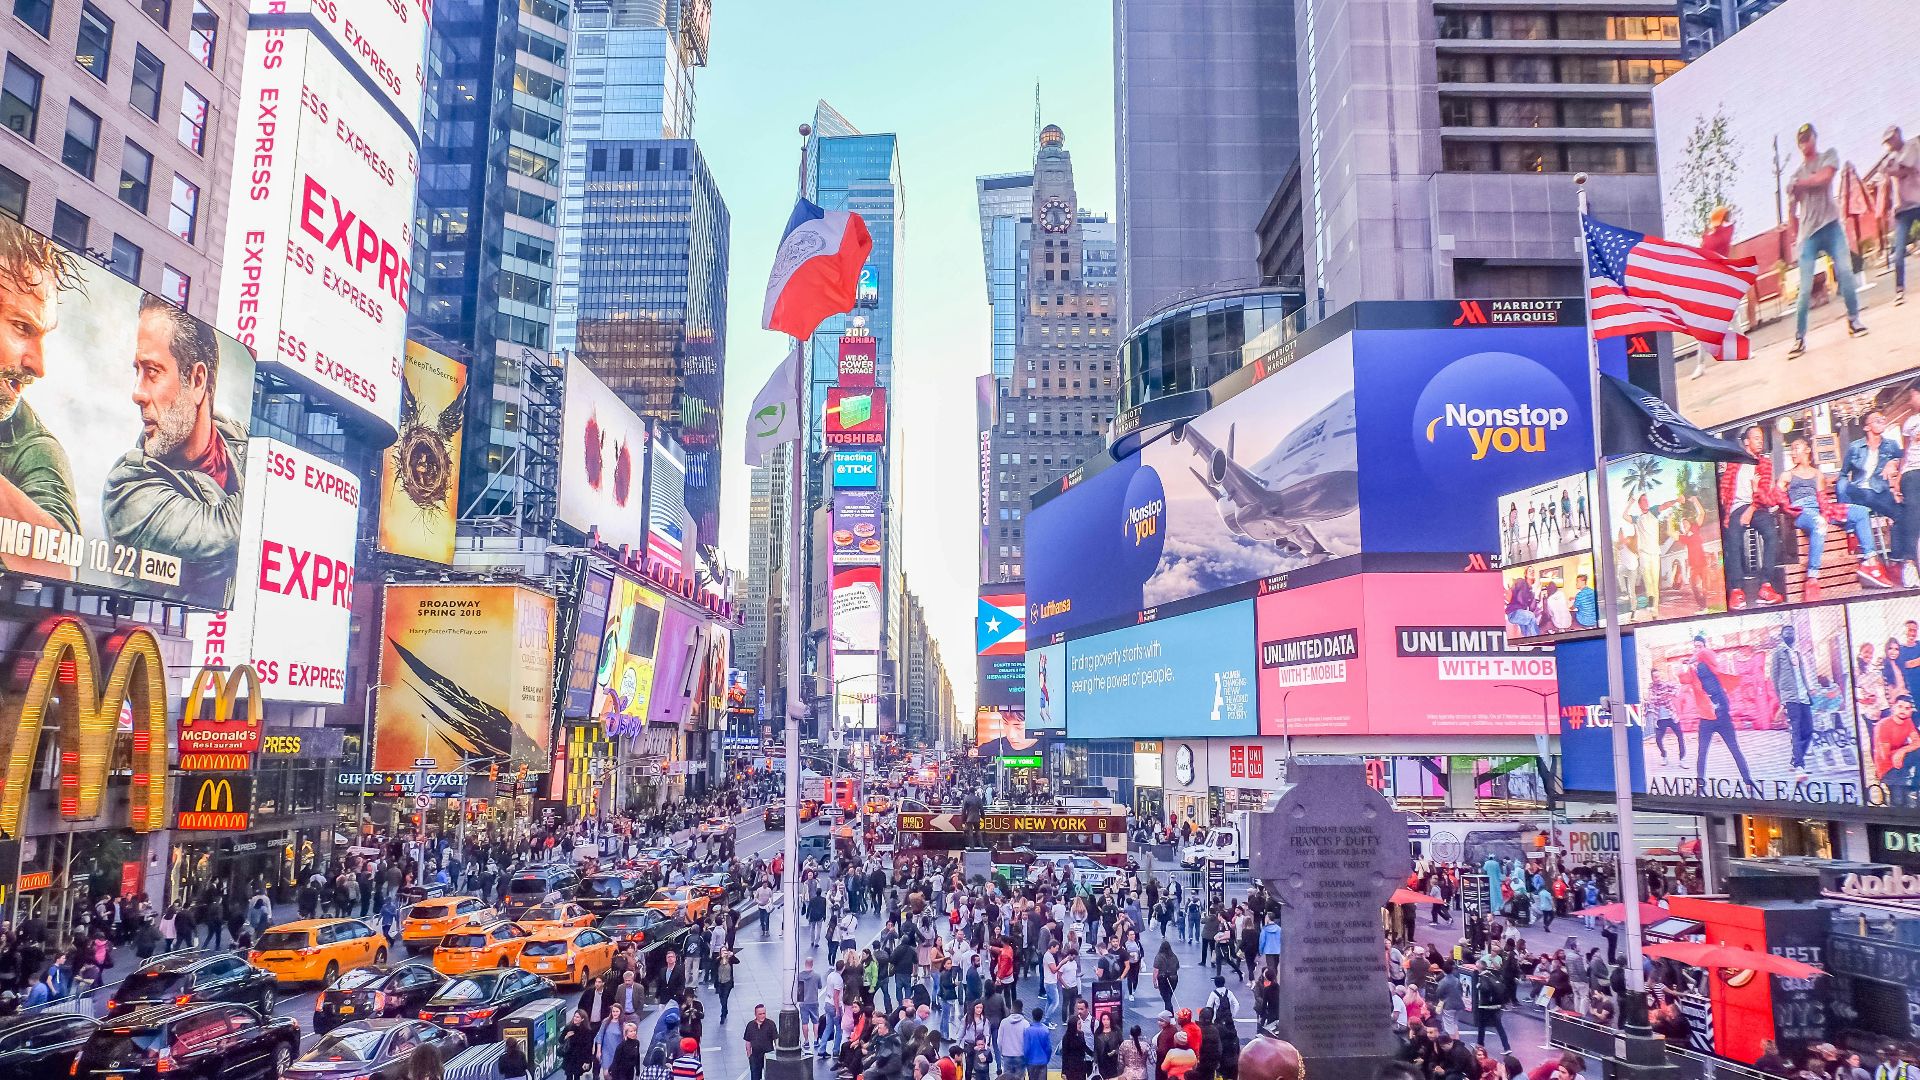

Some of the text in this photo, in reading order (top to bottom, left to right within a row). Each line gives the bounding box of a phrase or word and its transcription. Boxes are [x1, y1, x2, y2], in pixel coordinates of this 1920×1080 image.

[344, 19, 401, 96] EXPRESS
[249, 88, 279, 201] EXPRESS
[337, 119, 395, 187] EXPRESS
[323, 266, 384, 324] EXPRESS
[1492, 301, 1564, 311] MARRIOTT
[1492, 312, 1556, 322] MARQUIS
[1267, 340, 1297, 362] MARRIOTT
[839, 361, 874, 369] POWER
[1267, 353, 1294, 373] MARQUIS
[315, 351, 378, 403] EXPRESS
[1445, 403, 1568, 431] Nonstop
[826, 433, 884, 444] TOSHIBA
[1467, 426, 1547, 461] you
[844, 465, 874, 474] TDK
[304, 465, 360, 509] EXPRESS
[1129, 499, 1162, 525] Nonstop
[1135, 517, 1157, 547] you
[32, 525, 85, 568] DEAD
[89, 538, 138, 578] 10.22
[417, 609, 482, 617] SPRING 2018
[419, 600, 481, 608] BROADWAY
[1040, 599, 1071, 619] Lufthansa
[1071, 639, 1162, 672] Ending poverty starts with
[1264, 634, 1356, 665] UNLIMITED DATA
[288, 663, 345, 691] EXPRESS
[1281, 664, 1345, 684] WITH T-MOBILE
[1443, 660, 1490, 676] WITH
[1071, 665, 1175, 695] seeing the power of people.
[181, 730, 257, 743] McDonald's
[1249, 749, 1261, 761] UNI
[1249, 763, 1262, 775] QLO
[338, 773, 468, 786] GIFTS LUGAGE
[1650, 776, 1859, 806] AMERICAN EAGLE
[902, 816, 915, 824] BIG
[1014, 818, 1047, 830] NEW
[1050, 818, 1087, 830] YORK
[233, 841, 257, 852] EXPRESS
[1290, 836, 1333, 847] FRANCIS
[1346, 836, 1381, 847] DUFFY
[1569, 831, 1621, 851] PROUD
